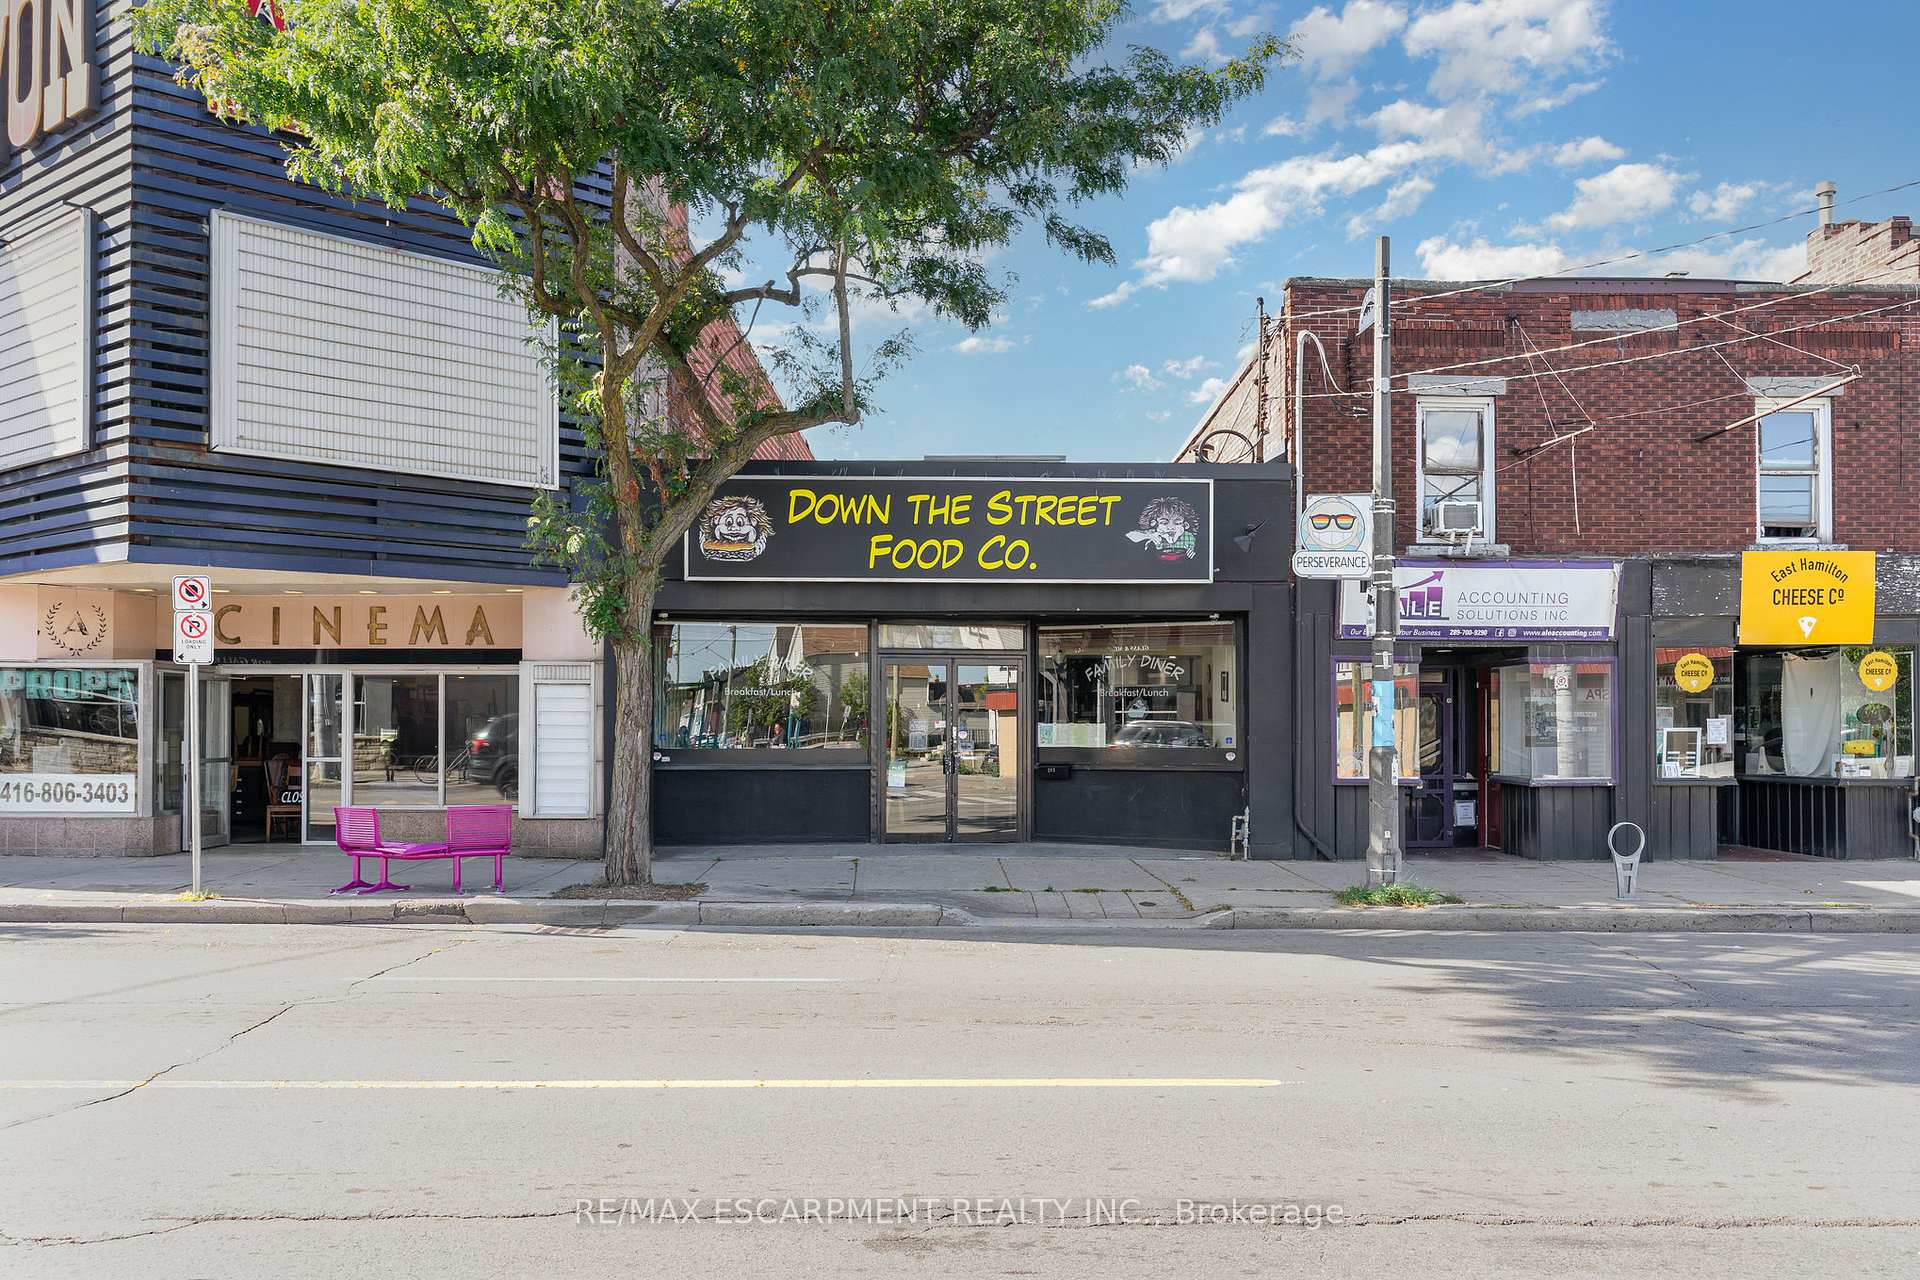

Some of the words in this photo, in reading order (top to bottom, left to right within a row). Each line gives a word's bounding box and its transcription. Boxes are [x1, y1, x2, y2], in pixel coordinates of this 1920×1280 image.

[0, 0, 90, 147] ON
[788, 489, 890, 525] DOWN
[907, 494, 973, 525] THE
[986, 490, 1121, 526] STREET
[869, 534, 964, 570] FOOD
[977, 534, 1037, 570] CO.
[1296, 556, 1366, 569] PERSEVERANCE
[1771, 562, 1797, 583] East
[1800, 558, 1848, 583] Hamilton
[1457, 591, 1569, 605] ACCOUNTING
[1773, 588, 1825, 606] CHEESE
[1457, 609, 1538, 621] SOLUTIONS
[1545, 609, 1568, 621] INC
[214, 604, 495, 646] CINEMA
[1414, 628, 1441, 637] Business
[1523, 628, 1603, 638] www.aleaccounting.com
[1084, 654, 1136, 682] FAMILY
[1140, 654, 1185, 681] DINER
[724, 687, 796, 698] Breakfast/Lunch
[1099, 687, 1169, 698] Breakfast/Lunch
[0, 782, 129, 803] 416-806-3403
